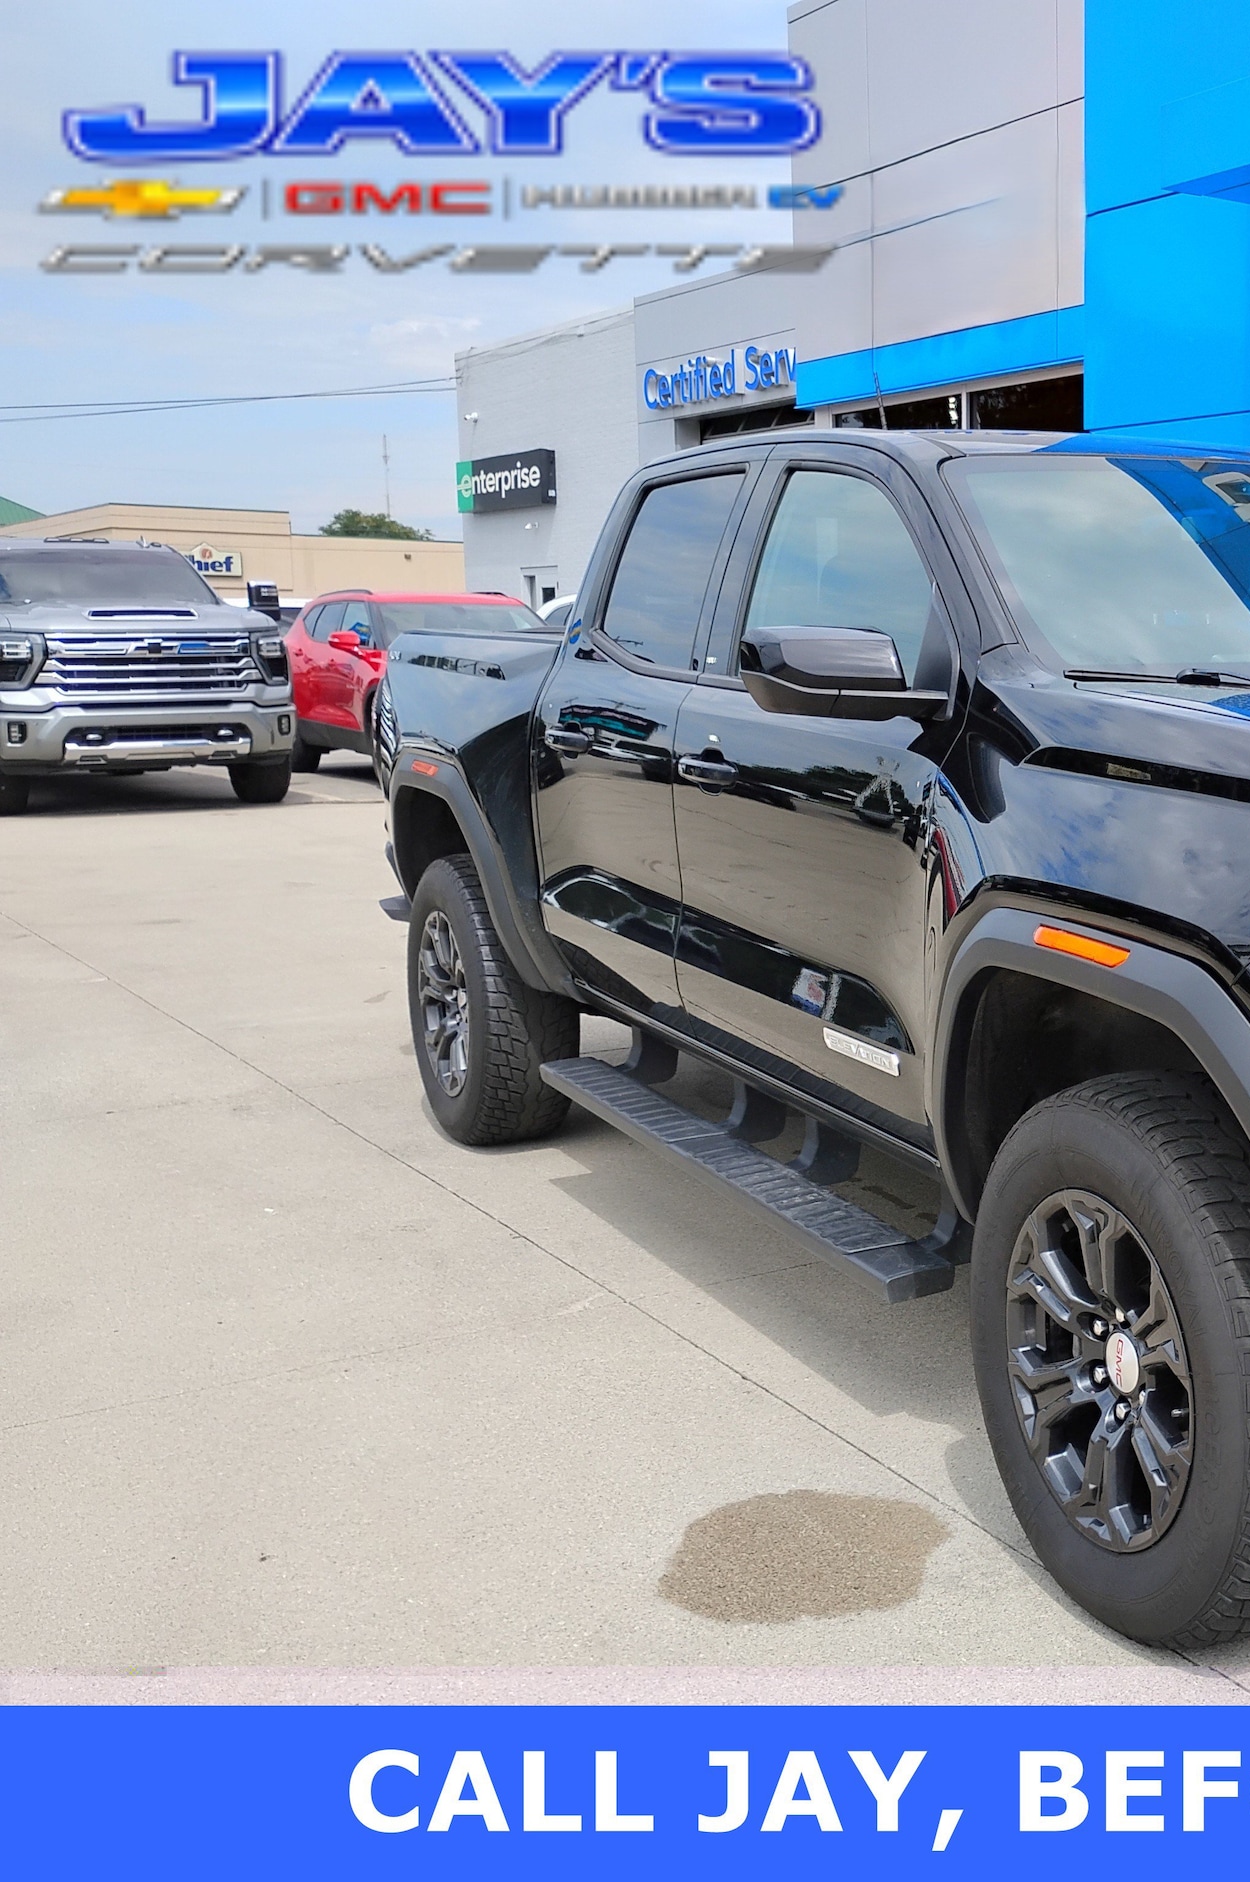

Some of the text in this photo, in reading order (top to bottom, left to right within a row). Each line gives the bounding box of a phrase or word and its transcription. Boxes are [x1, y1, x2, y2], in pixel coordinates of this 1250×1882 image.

[644, 348, 736, 410] Certified
[459, 461, 541, 499] enterprise
[185, 554, 234, 573] hief
[828, 1035, 891, 1068] ELEVATION
[1115, 1338, 1124, 1388] GMC
